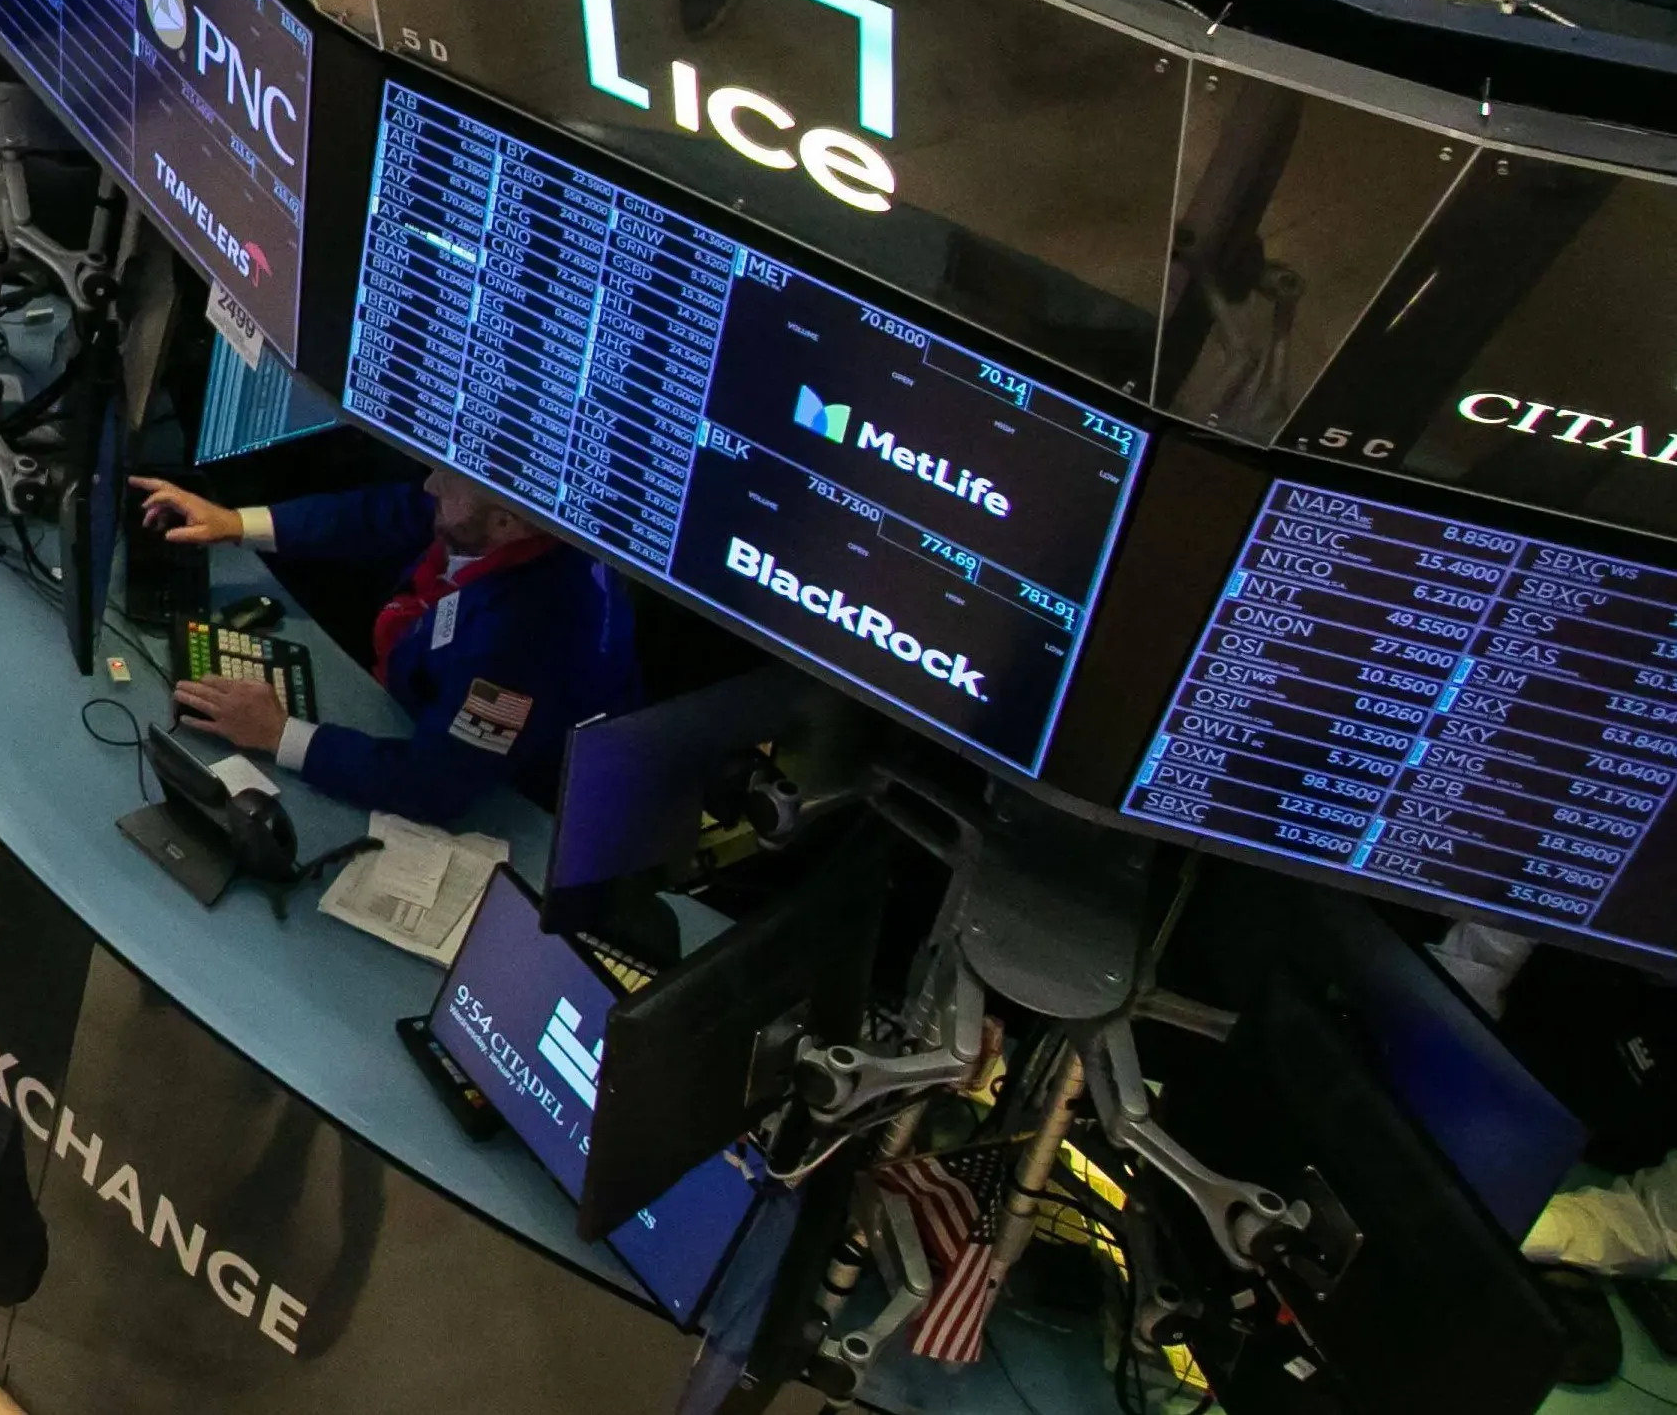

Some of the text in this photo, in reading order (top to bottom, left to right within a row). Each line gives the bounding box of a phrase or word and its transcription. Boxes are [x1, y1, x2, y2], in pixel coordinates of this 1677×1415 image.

[192, 4, 298, 167] PNC
[394, 90, 417, 110] AB
[392, 110, 425, 134] ADT
[387, 148, 417, 171] AFL
[503, 159, 544, 187] CABO
[506, 142, 529, 162] BY
[153, 151, 251, 279] TRAVELERS
[498, 199, 531, 225] CFG
[620, 216, 664, 246] GNW
[623, 196, 664, 224] GHLD
[609, 275, 634, 296] HG
[217, 293, 255, 340] 2499
[595, 348, 629, 374] KEY
[748, 254, 1134, 444] MET 70.8100 70.14 71.12
[856, 421, 1011, 519] MetLife
[710, 428, 1077, 621] BLK 781.7300 774.69 781.91
[1443, 526, 1516, 554] 8.8500
[726, 536, 989, 703] BlackRock.
[1234, 606, 1454, 670] ONON 27.5000
[1247, 577, 1469, 642] NYT 49.5500
[1170, 741, 1381, 803] OXM 98.3500
[1442, 719, 1671, 785] SKY 70.0400
[1146, 791, 1353, 854] SBXC 10.3600
[1372, 849, 1588, 916] TPH 35.0900
[454, 984, 494, 1036] 9:54
[489, 1032, 565, 1126] CITADEL
